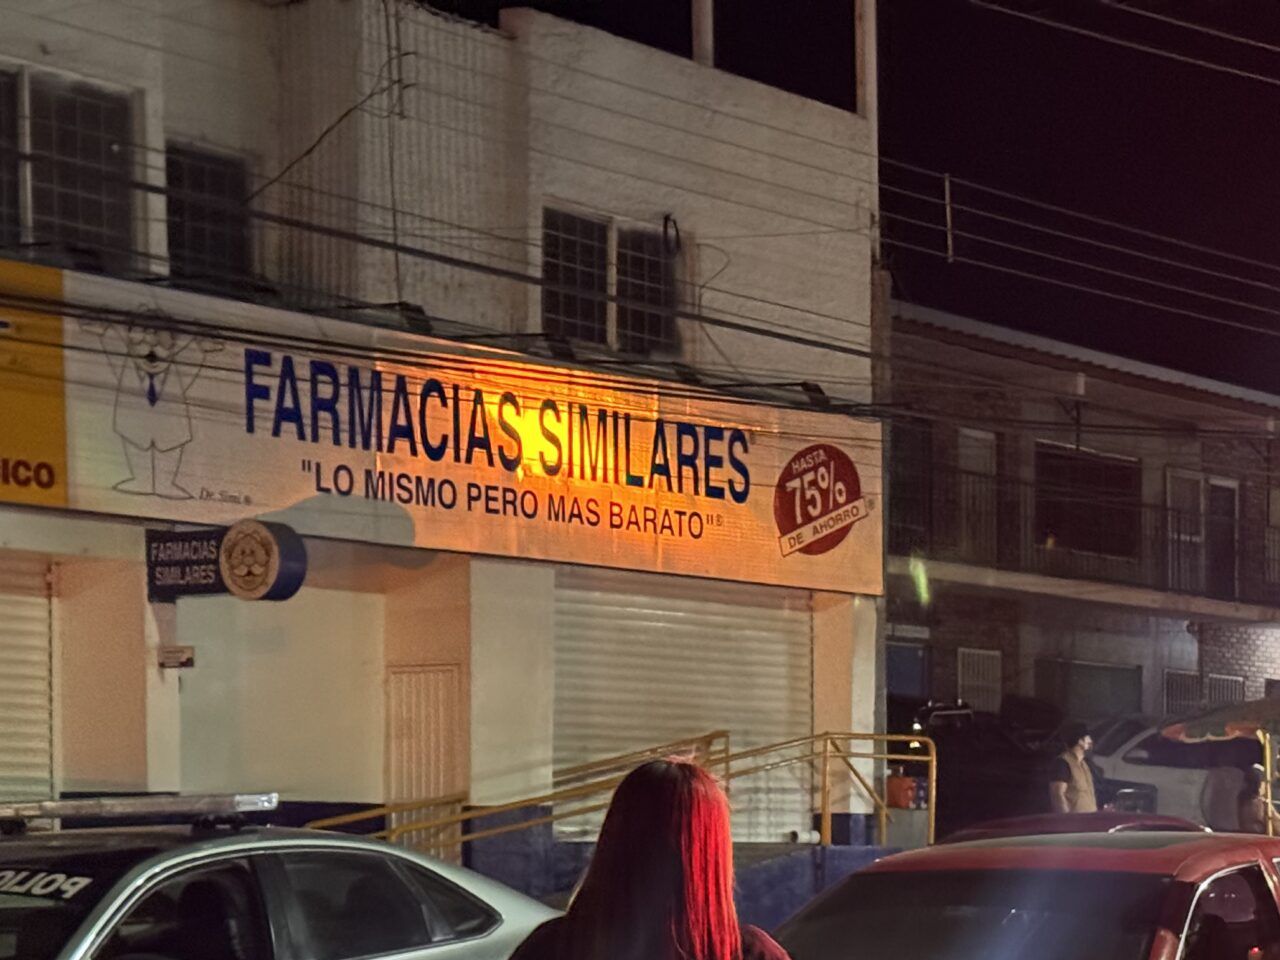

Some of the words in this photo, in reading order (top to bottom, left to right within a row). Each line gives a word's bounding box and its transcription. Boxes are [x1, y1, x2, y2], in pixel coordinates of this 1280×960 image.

[244, 348, 521, 472] FARMACIAS
[539, 398, 749, 504] SIMILARES
[1, 458, 56, 489] ICO
[792, 449, 828, 473] HASTA
[364, 469, 457, 510] MISMO
[467, 482, 538, 519] PERO
[548, 494, 600, 527] MAS
[786, 460, 846, 524] 75%
[788, 533, 804, 549] DE
[812, 505, 860, 536] AHORRO
[151, 540, 217, 562] FARMACIAS
[154, 564, 216, 585] SIMILARES
